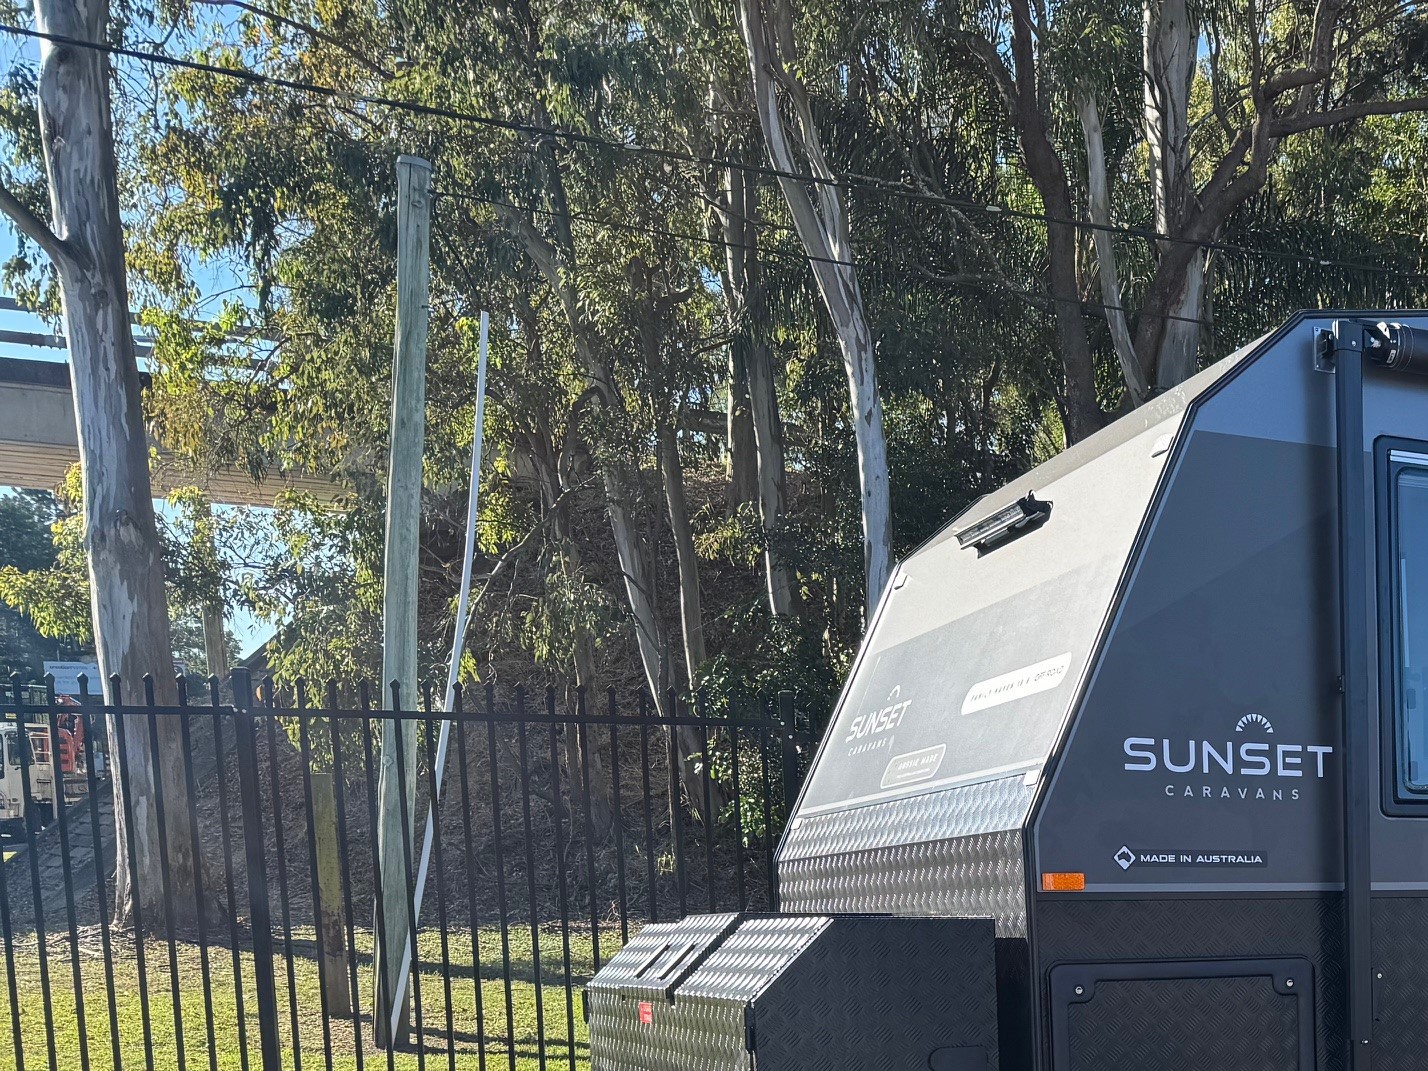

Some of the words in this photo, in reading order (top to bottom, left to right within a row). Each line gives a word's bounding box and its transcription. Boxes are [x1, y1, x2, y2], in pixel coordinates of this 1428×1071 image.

[845, 699, 913, 744] SUNSET
[847, 737, 887, 757] CARAVANS
[1123, 737, 1333, 778] SUNSET
[1165, 785, 1300, 801] CARAVANS
[1140, 854, 1176, 863] MADE
[1180, 854, 1192, 863] IN
[1196, 854, 1263, 864] AUSTRALIA
